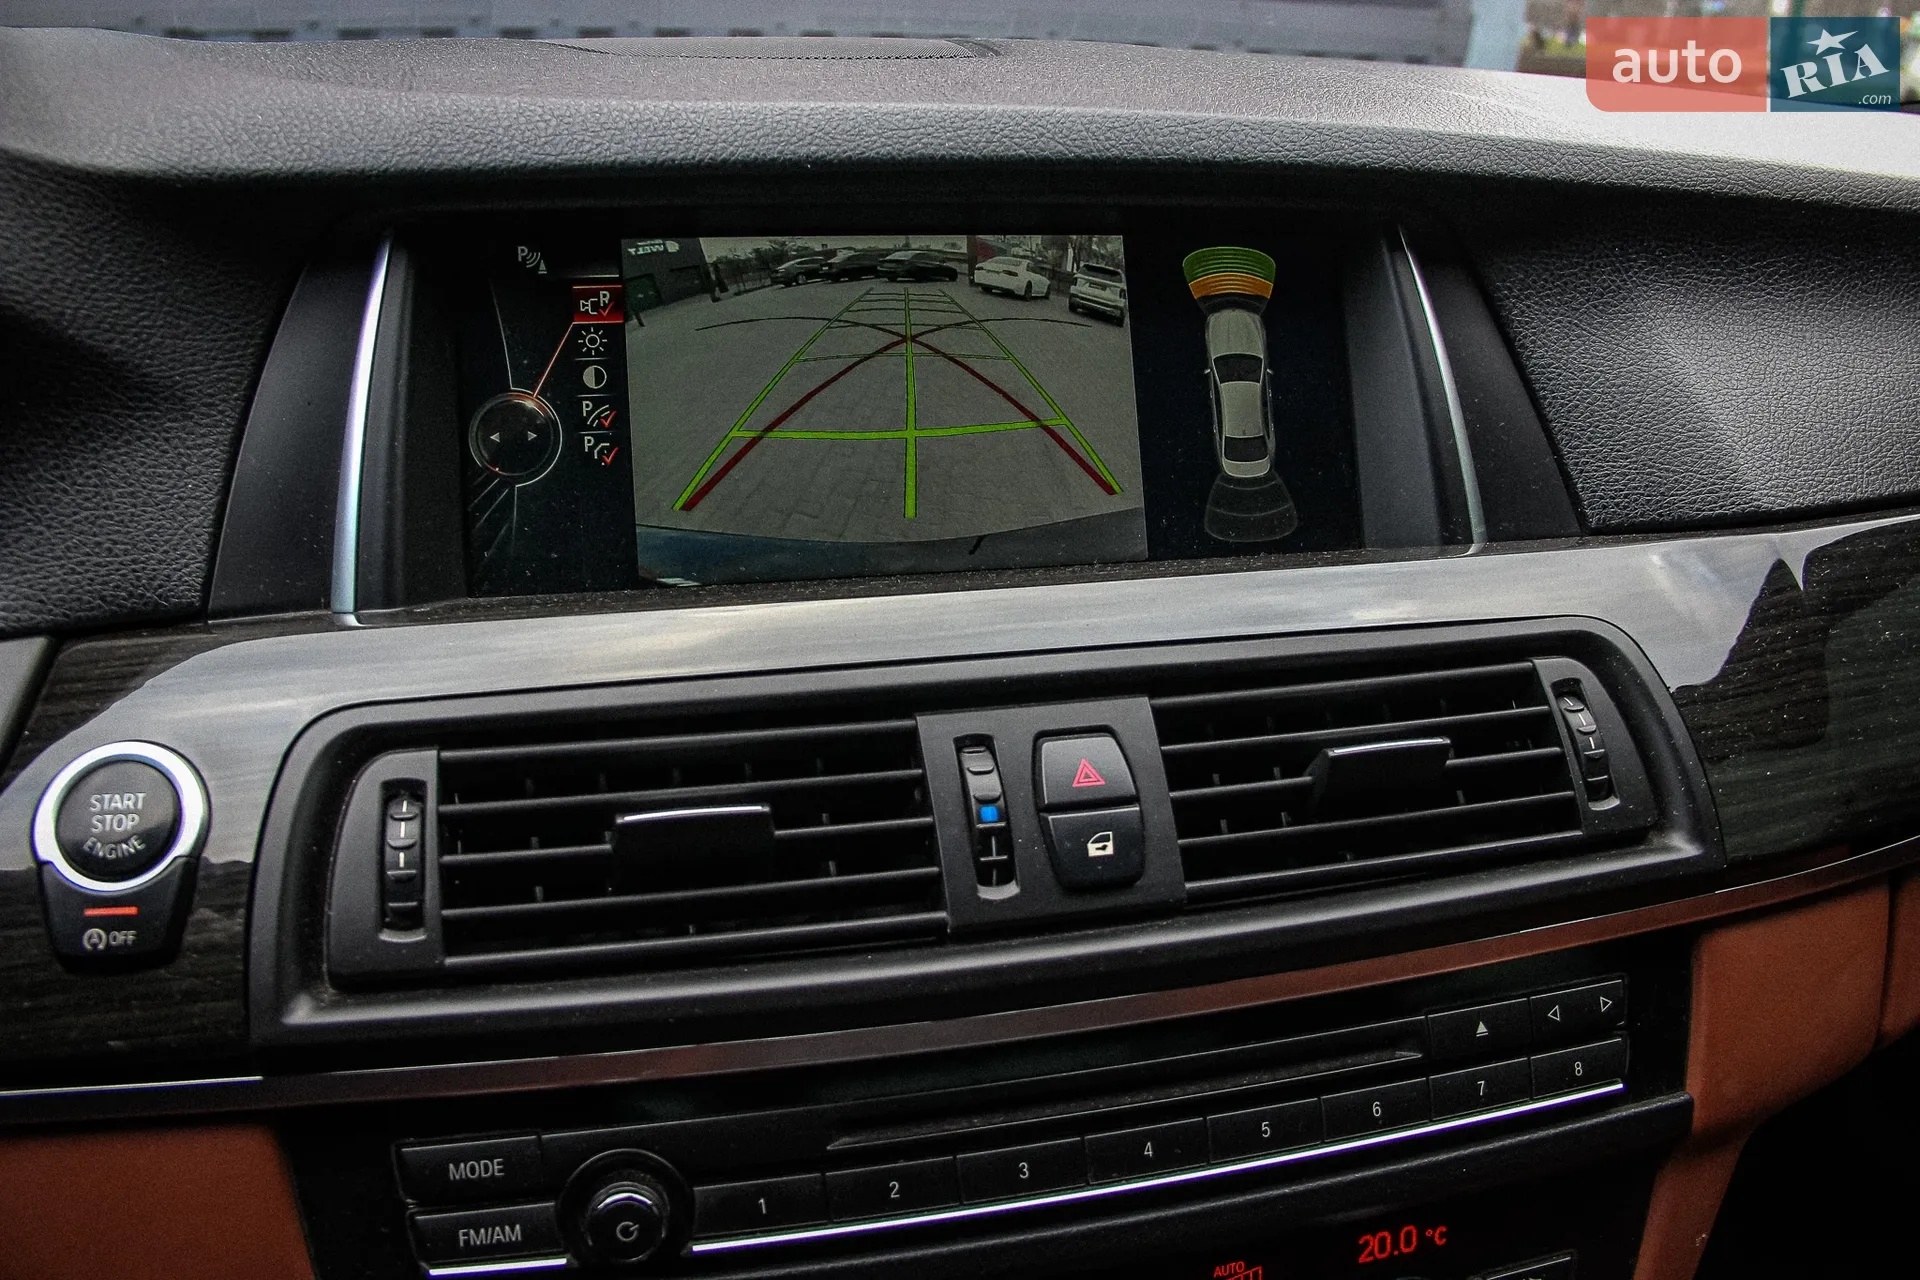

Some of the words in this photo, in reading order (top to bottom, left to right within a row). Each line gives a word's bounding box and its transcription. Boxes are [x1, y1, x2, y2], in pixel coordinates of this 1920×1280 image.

[89, 792, 147, 812] START
[91, 814, 140, 834] STOP
[82, 835, 145, 859] ENGINE
[109, 930, 137, 946] OFF
[757, 1198, 767, 1214] 1
[889, 1181, 900, 1198] 2
[1018, 1162, 1029, 1179] 3
[1143, 1141, 1154, 1158] 4
[1260, 1121, 1270, 1138] 5
[1372, 1101, 1382, 1118] 6
[1476, 1080, 1485, 1097] 7
[1573, 1060, 1583, 1077] 8
[448, 1158, 505, 1181] MODE
[458, 1224, 522, 1247] FM/AM
[1358, 1225, 1417, 1263] 20.0
[1213, 1261, 1245, 1278] AUTO
